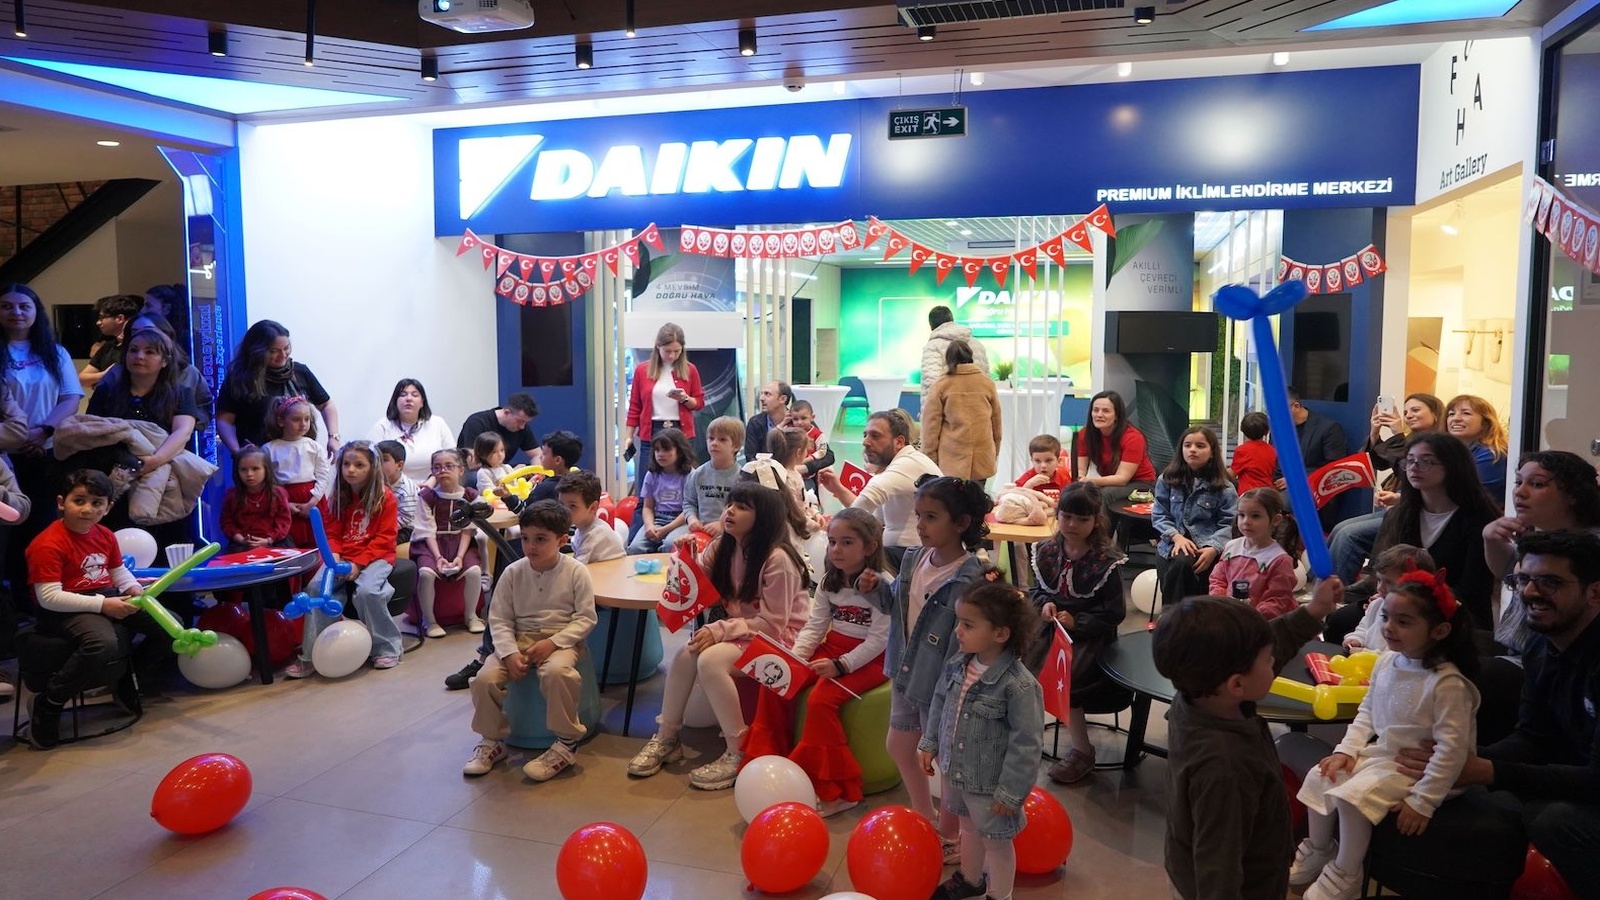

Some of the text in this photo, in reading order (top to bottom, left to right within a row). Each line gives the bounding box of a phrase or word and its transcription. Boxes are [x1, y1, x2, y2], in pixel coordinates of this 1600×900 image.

[893, 115, 920, 125] ÇIKIŞ
[894, 125, 919, 134] EXIT
[530, 133, 852, 202] DAIKIN
[1439, 154, 1488, 190] Art Gallery
[1096, 177, 1393, 202] PREMIUM İKLİMLENDİRME MERKEZİ
[1132, 260, 1160, 271] AKILLI
[690, 291, 716, 299] HAVA
[1147, 283, 1183, 295] VERİMLİ
[214, 304, 226, 366] Experience
[681, 602, 705, 623] ATA
